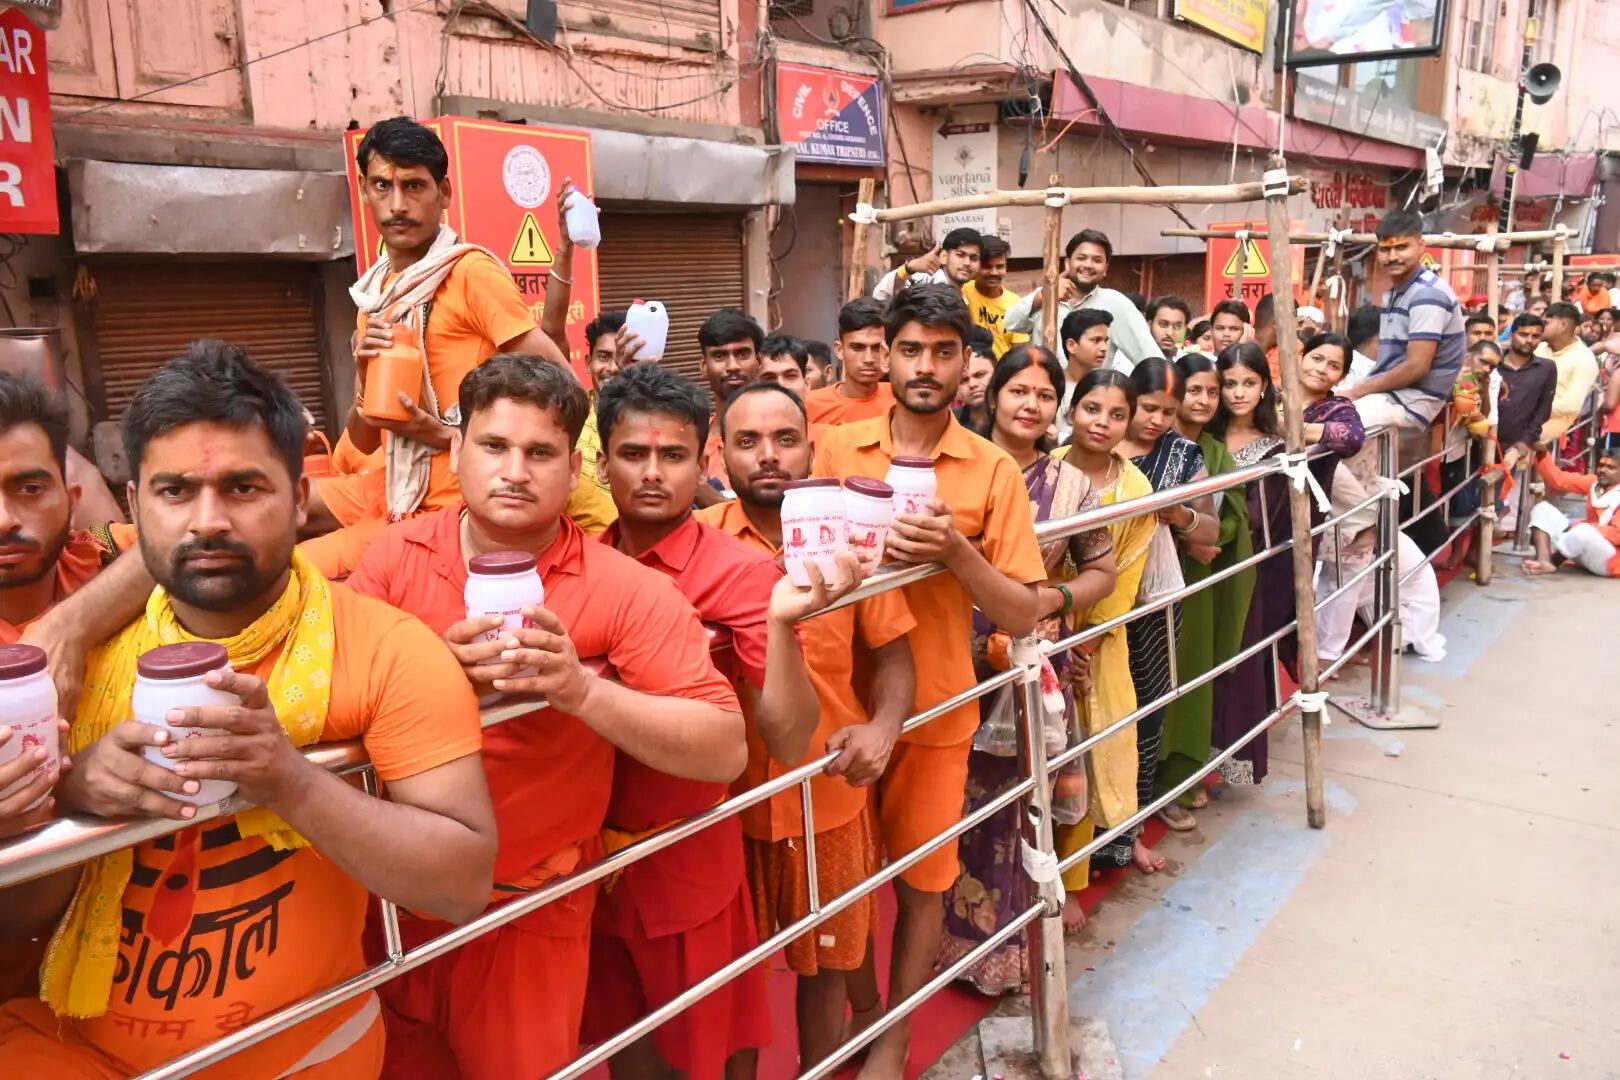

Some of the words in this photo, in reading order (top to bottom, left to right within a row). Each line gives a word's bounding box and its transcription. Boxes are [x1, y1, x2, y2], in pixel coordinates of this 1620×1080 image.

[792, 84, 812, 118] CIVIL
[841, 80, 877, 135] DEFENCE
[816, 118, 850, 133] OFFICE
[939, 171, 991, 187] vandana
[944, 214, 985, 225] BANARASI
[511, 273, 550, 294] खतर
